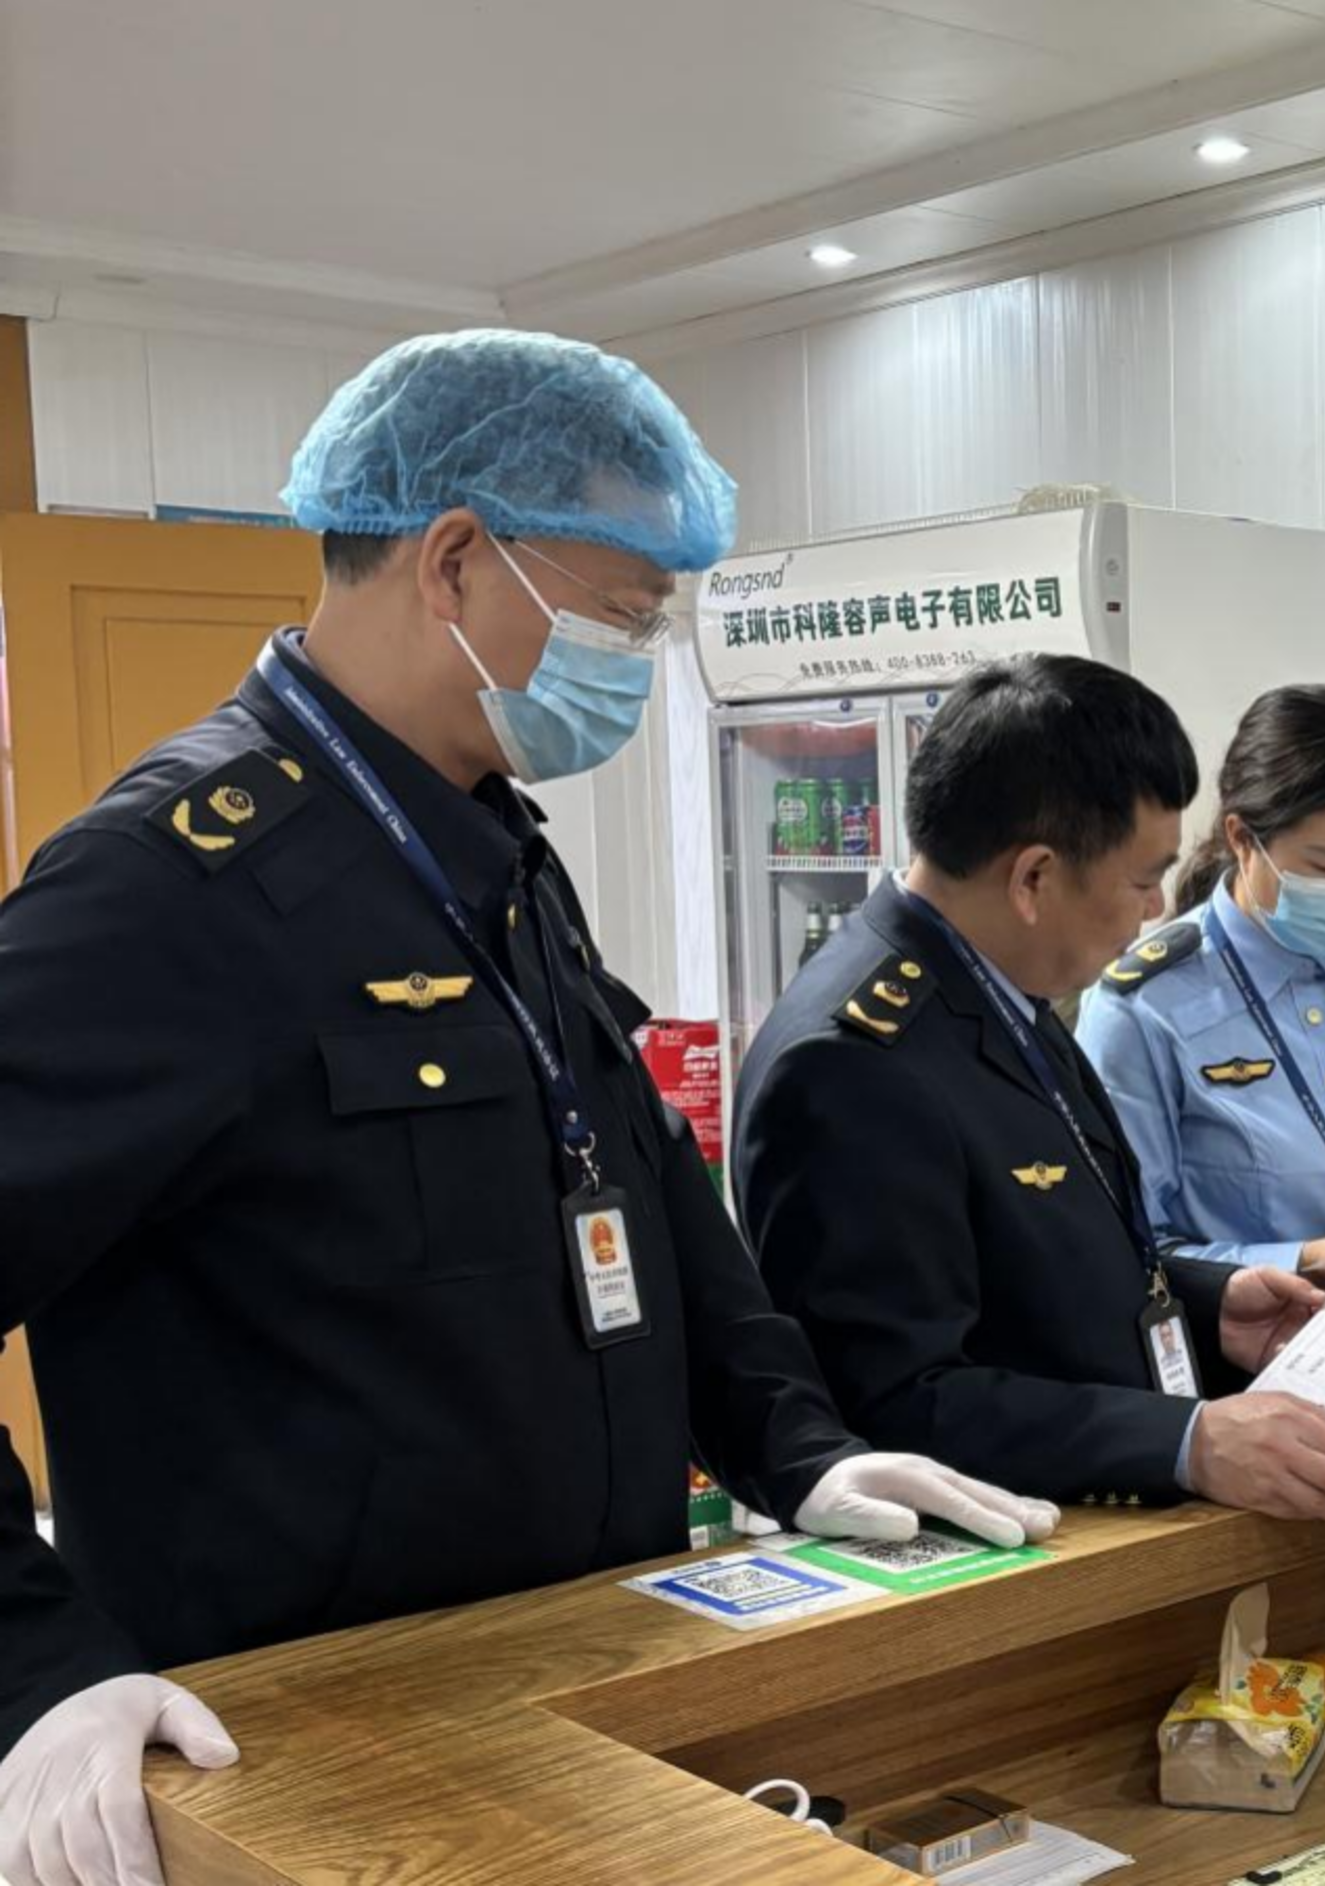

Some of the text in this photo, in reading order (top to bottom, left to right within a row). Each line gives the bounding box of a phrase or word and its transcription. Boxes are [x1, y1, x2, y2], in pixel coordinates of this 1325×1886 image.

[708, 562, 786, 600] Rongsnd
[723, 576, 1063, 648] 深圳市科隆容声电子有限公司
[329, 738, 346, 759] Law
[346, 760, 390, 815] Enforcement
[386, 814, 408, 844] China
